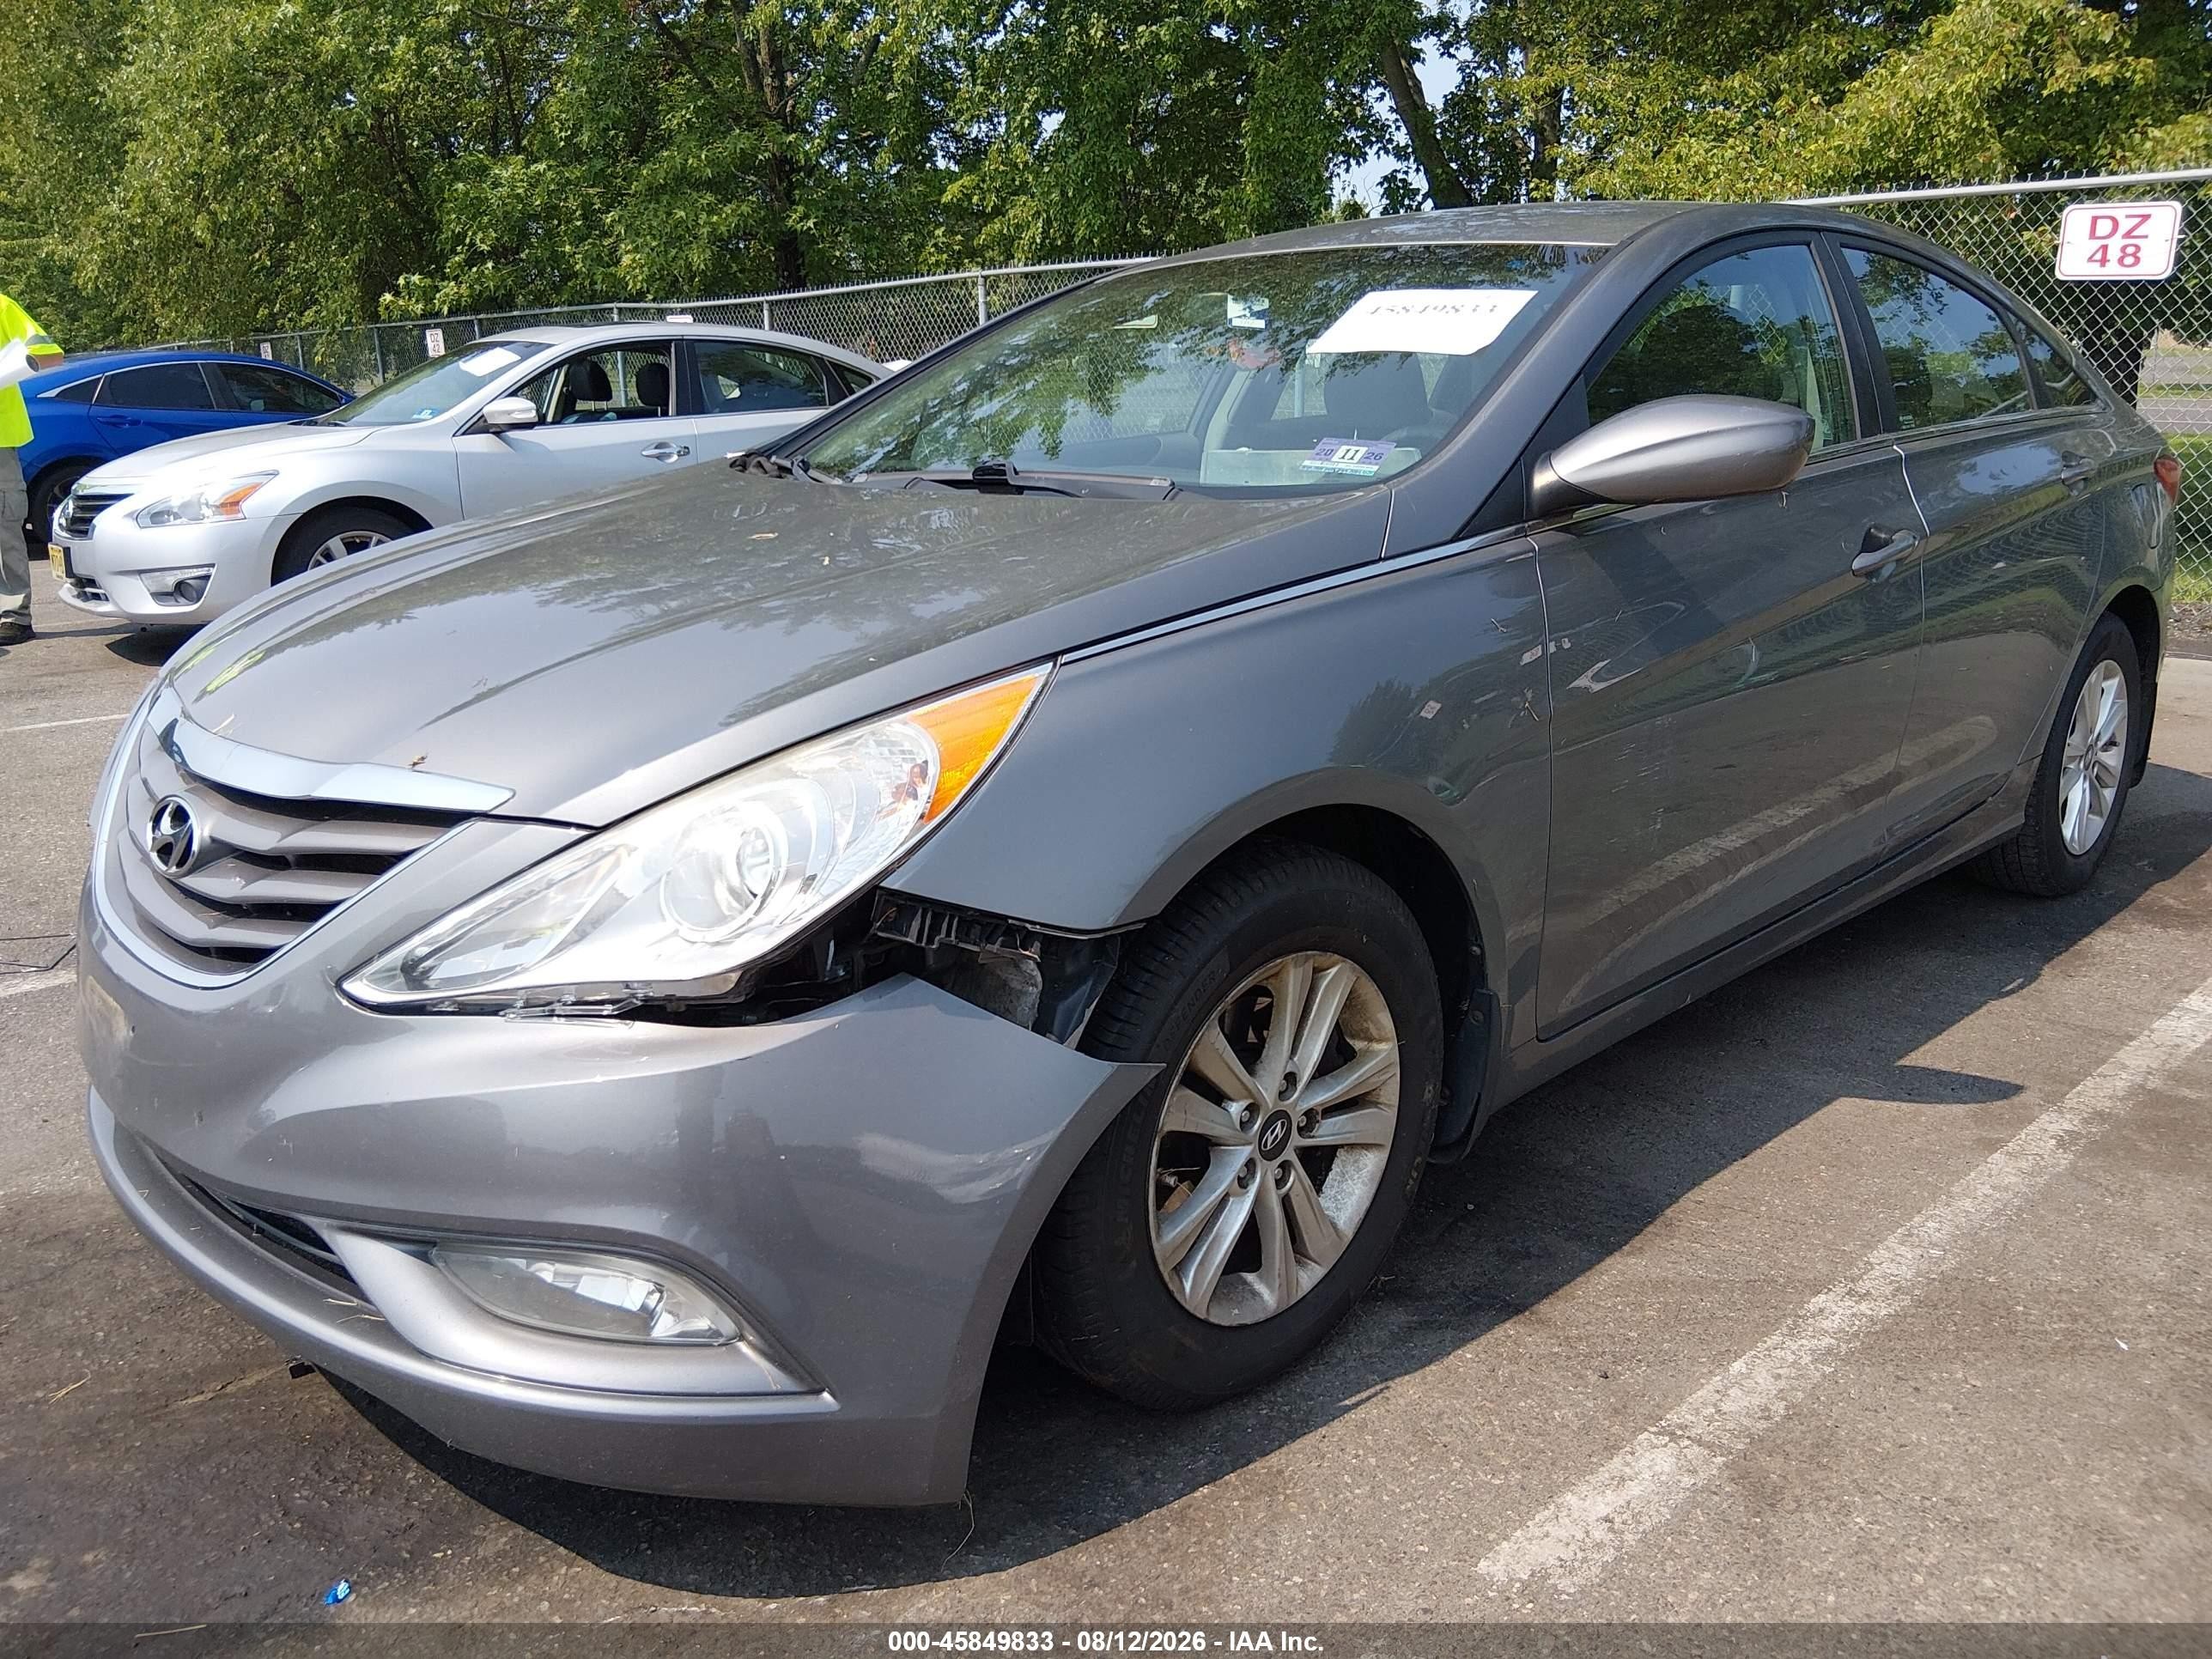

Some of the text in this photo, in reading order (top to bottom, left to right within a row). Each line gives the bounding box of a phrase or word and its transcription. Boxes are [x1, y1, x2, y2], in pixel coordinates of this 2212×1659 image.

[2088, 214, 2151, 240] DZ
[2087, 244, 2142, 267] 48
[430, 333, 440, 343] DZ
[1316, 447, 1383, 461] 20 11 26
